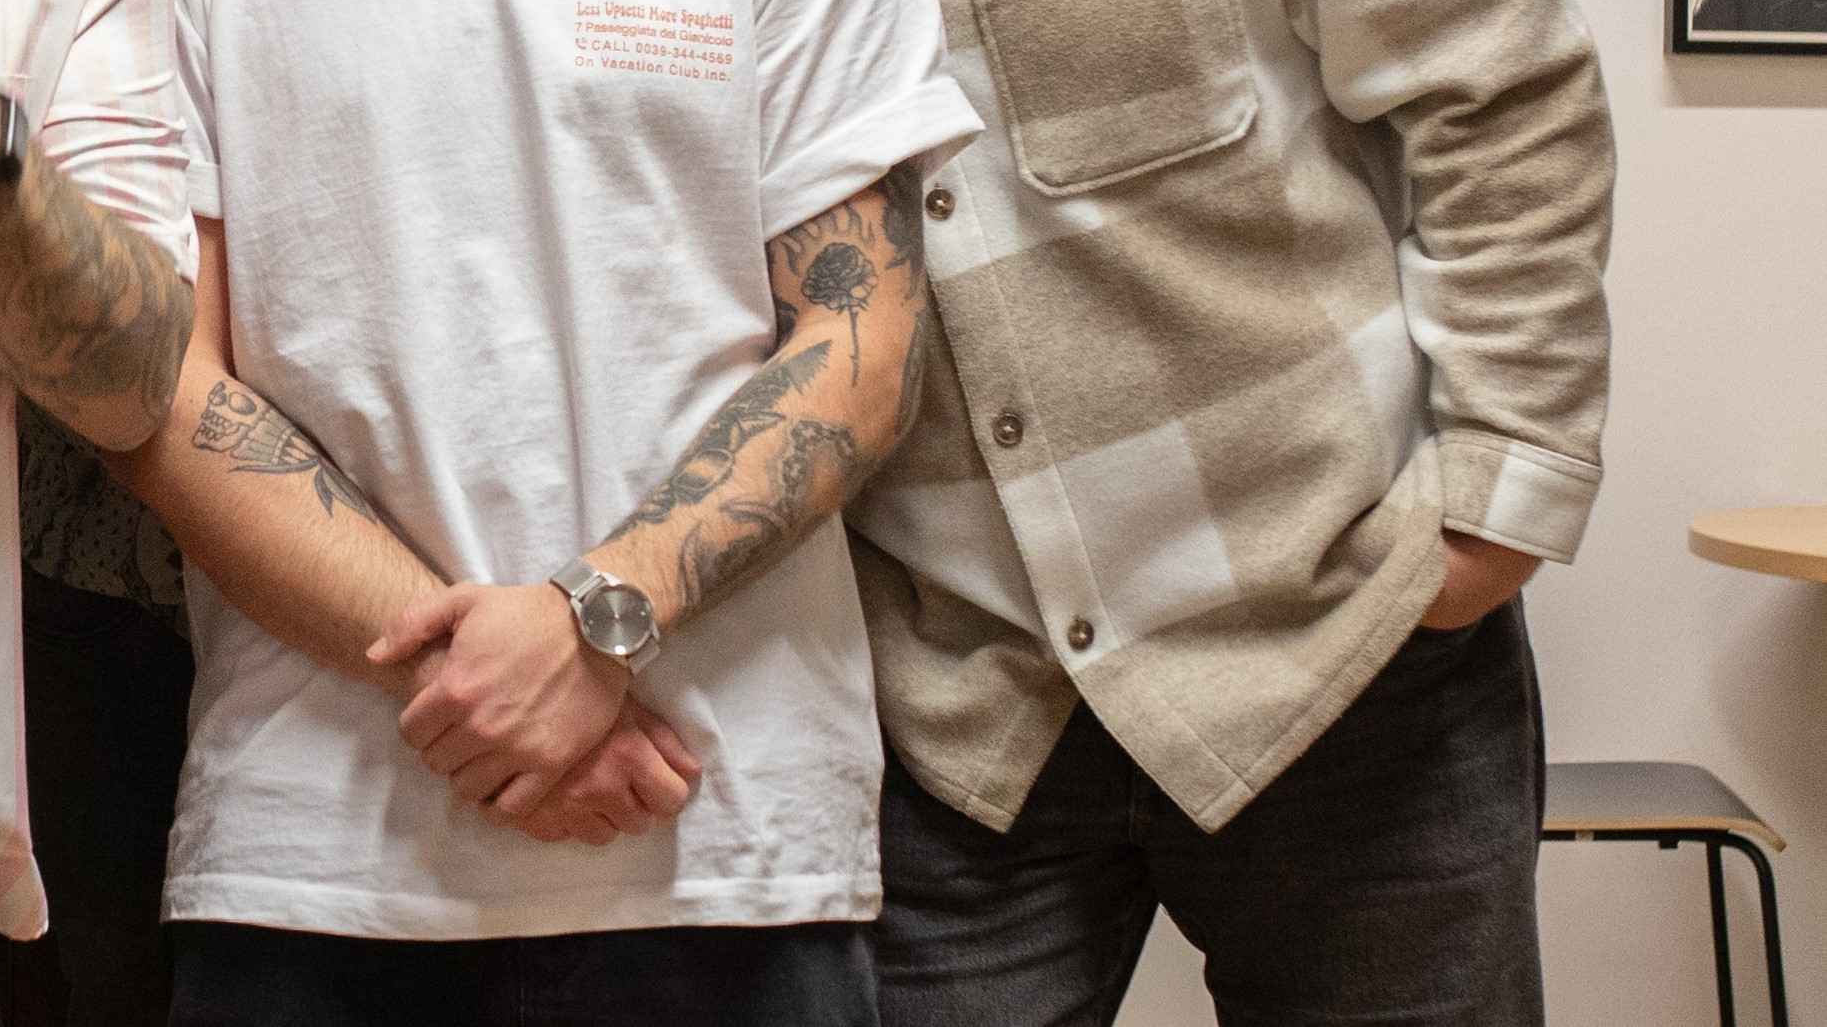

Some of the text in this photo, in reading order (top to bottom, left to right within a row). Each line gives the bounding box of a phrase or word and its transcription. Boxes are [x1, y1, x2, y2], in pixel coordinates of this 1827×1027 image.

[590, 40, 630, 53] CALL
[574, 56, 595, 68] On
[600, 56, 663, 74] Vacation
[669, 63, 701, 79] Club
